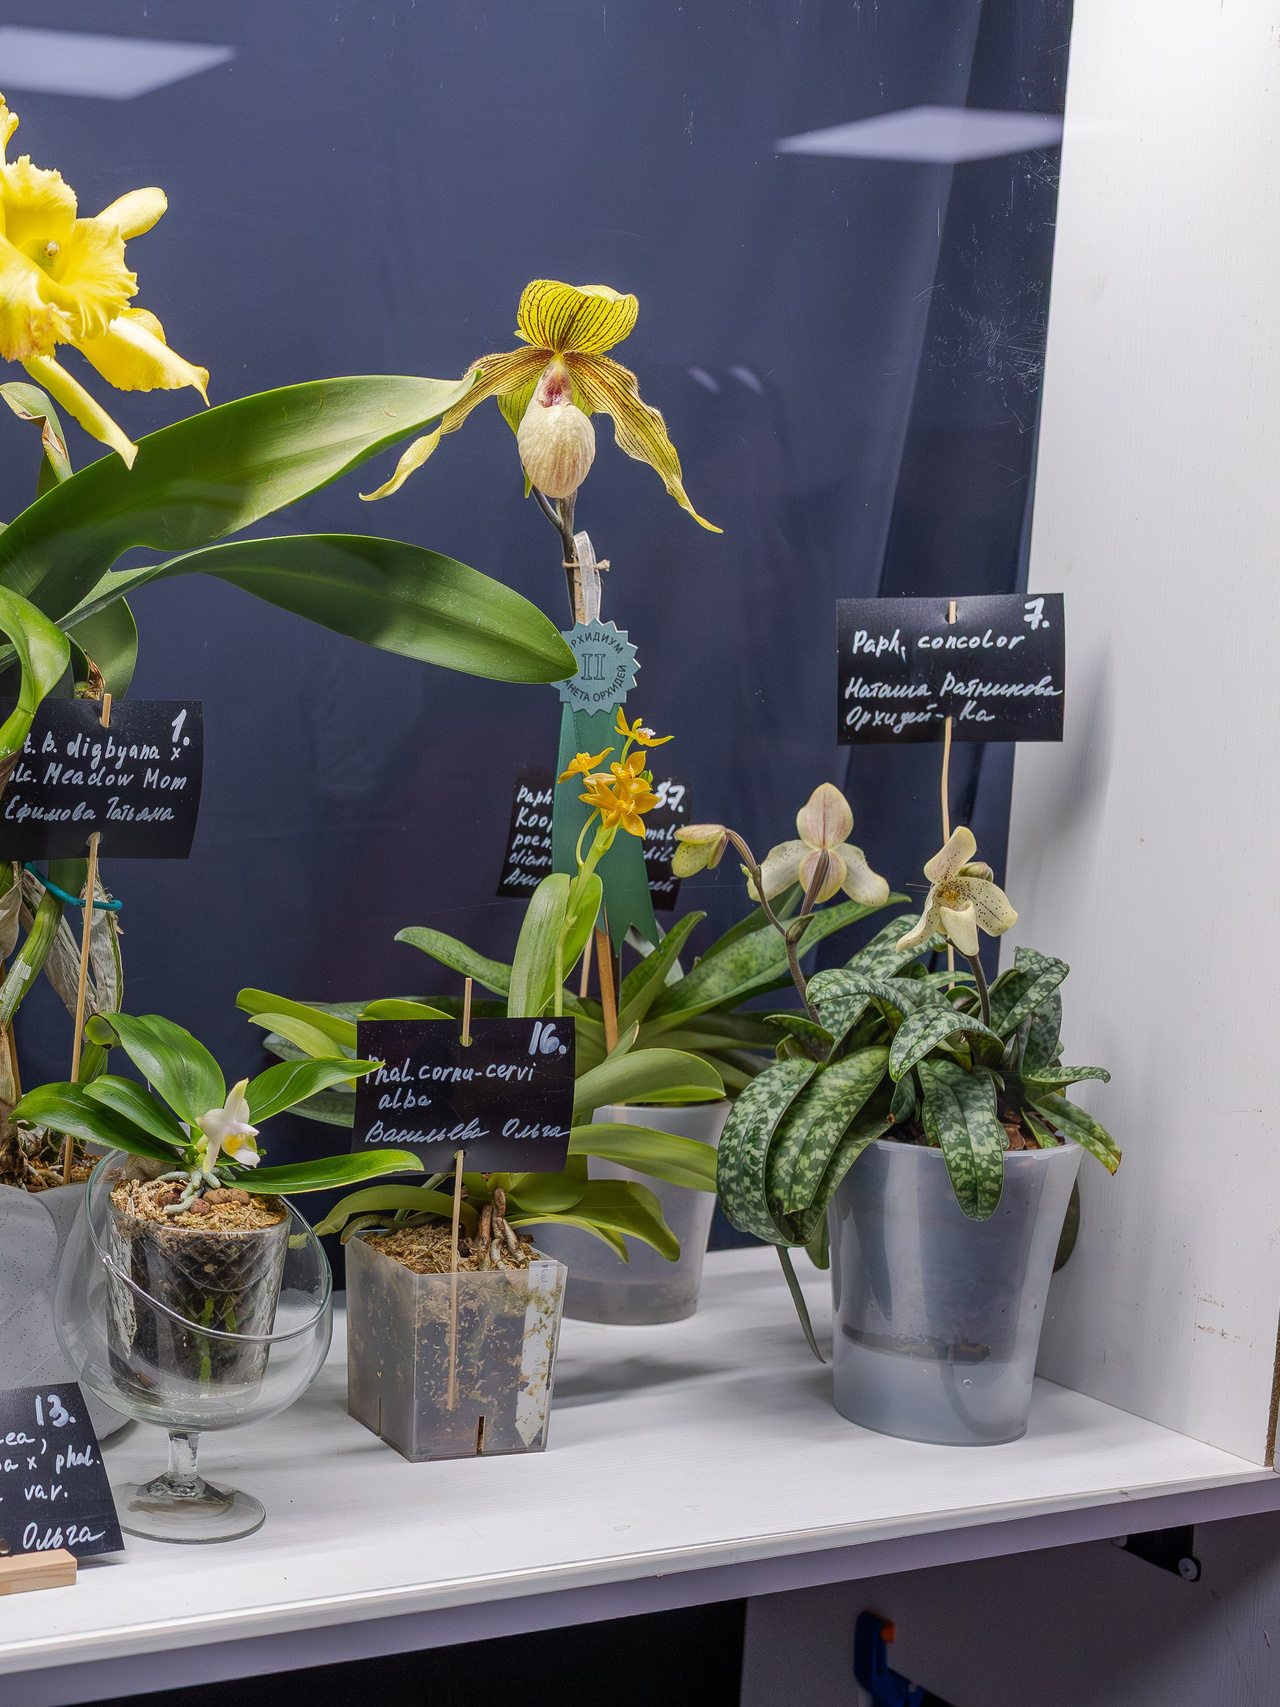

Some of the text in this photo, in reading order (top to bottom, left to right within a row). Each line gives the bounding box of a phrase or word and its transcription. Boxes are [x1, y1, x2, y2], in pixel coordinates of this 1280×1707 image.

[1023, 596, 1050, 631] 7.
[570, 632, 624, 654] РХИДИУМ
[917, 628, 1026, 650] concolor
[580, 653, 607, 681] II
[563, 664, 627, 702] АНЕТА ОРХИДЕЙ
[844, 676, 932, 699] Наташа
[171, 708, 191, 747] 1.
[66, 732, 161, 770] digbyana
[42, 762, 135, 786] Meadow
[143, 767, 188, 790] Mom
[4, 795, 175, 824] Ефимова Татьяна
[527, 1020, 568, 1056] 16.
[418, 1062, 537, 1083] cornu-cervi
[378, 1087, 433, 1110] alba
[364, 1117, 571, 1143] Васильева Ольга
[34, 1394, 76, 1428] 13.
[55, 1444, 101, 1475] phal.
[23, 1483, 69, 1501] var.
[22, 1521, 107, 1551] Ольга
